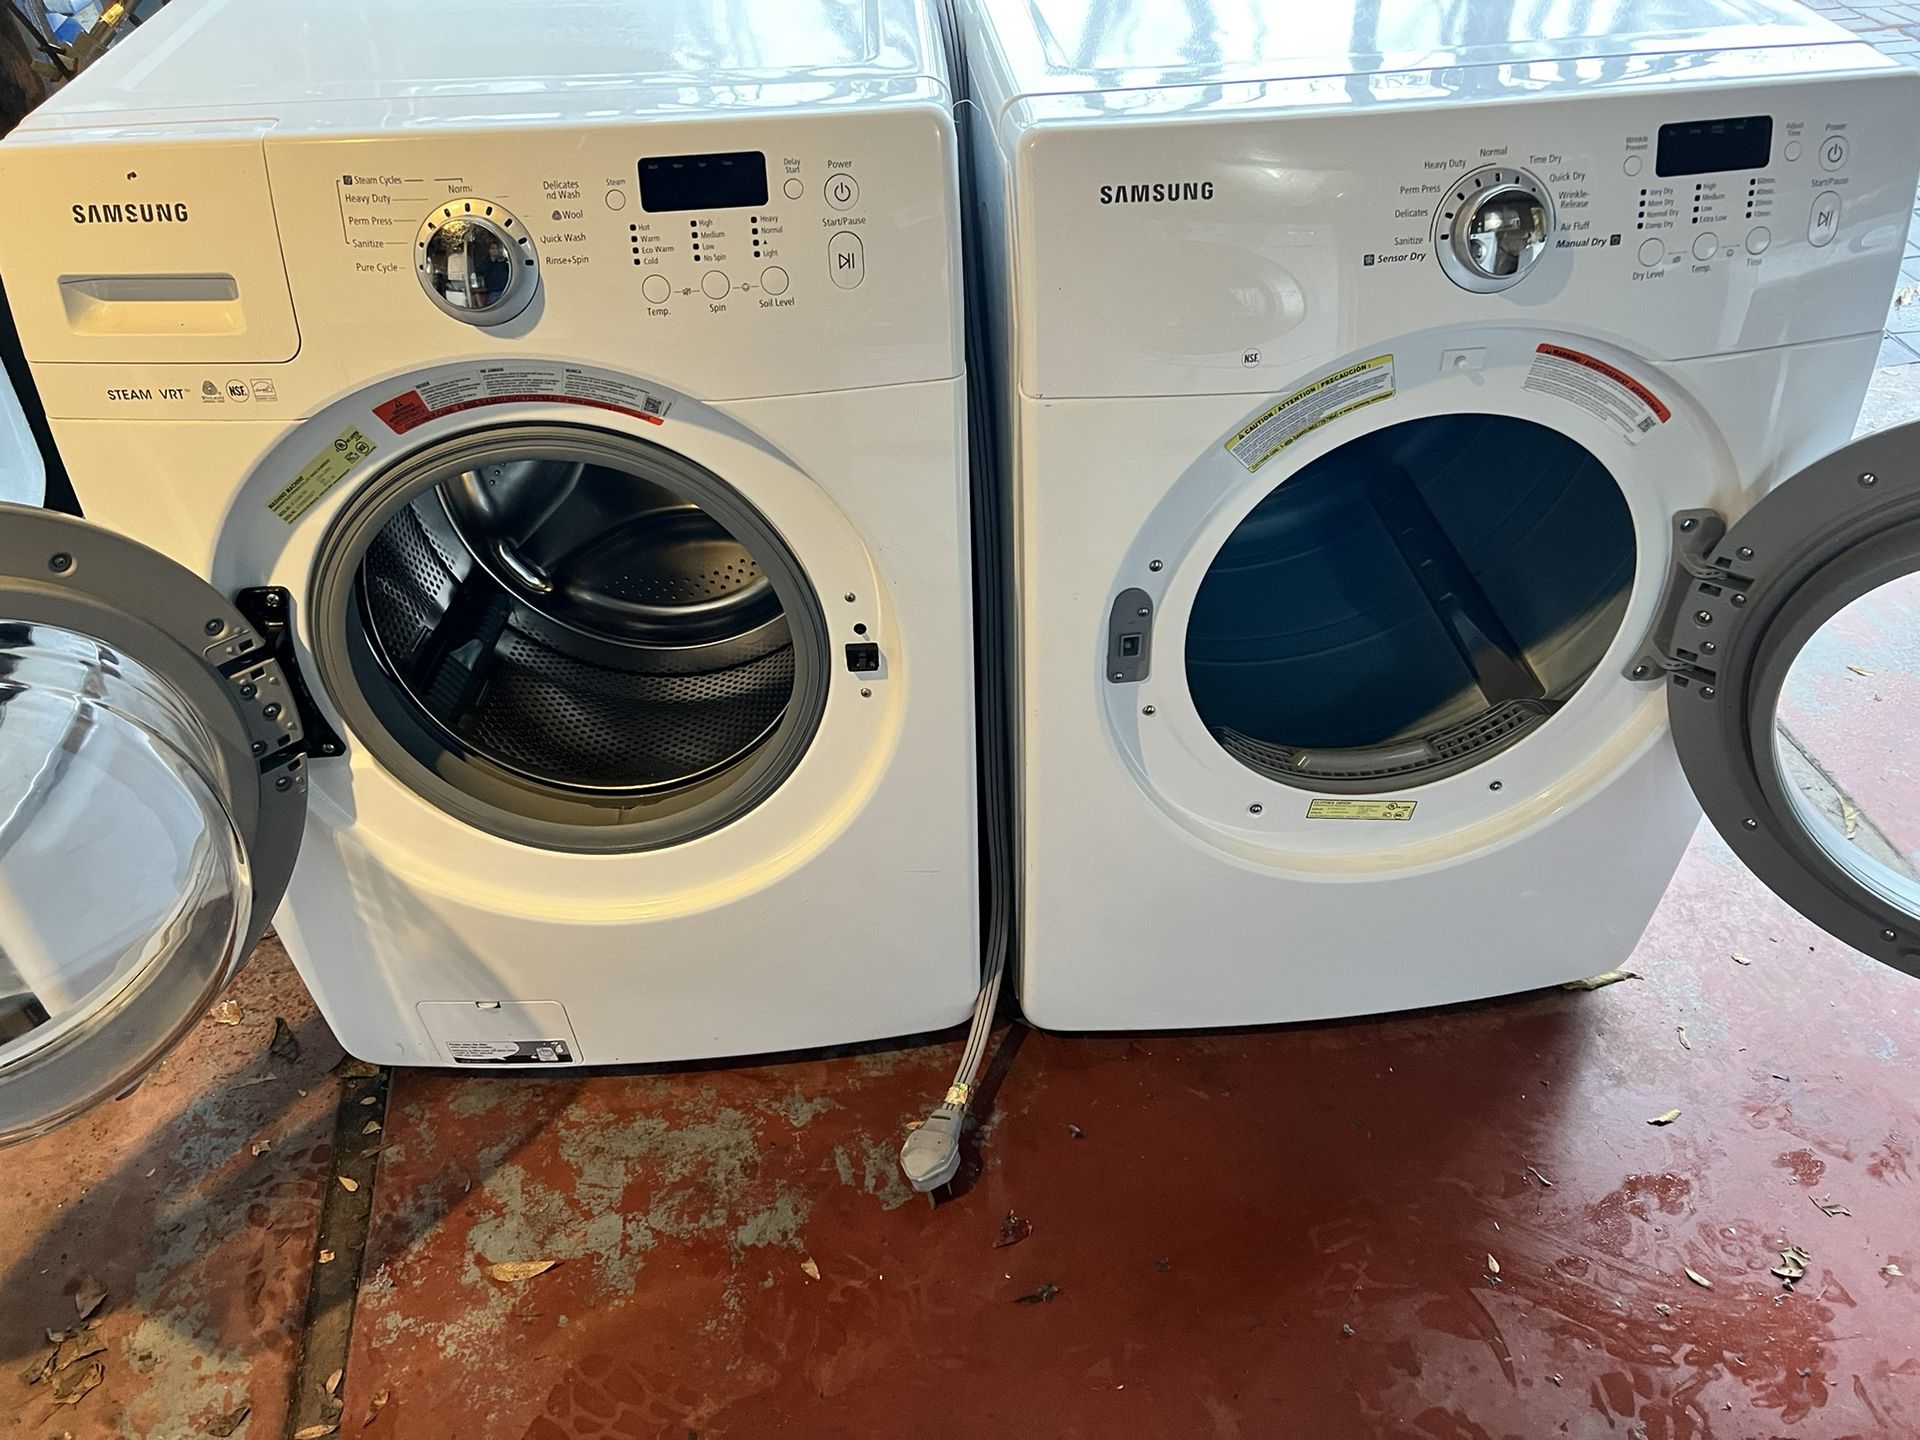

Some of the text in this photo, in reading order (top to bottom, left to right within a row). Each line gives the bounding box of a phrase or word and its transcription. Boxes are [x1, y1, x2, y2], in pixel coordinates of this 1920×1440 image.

[1825, 123, 1847, 131] Power
[1480, 147, 1508, 157] Normal
[1424, 159, 1467, 169] Heavy Duty
[1529, 154, 1562, 164] Time Dry
[828, 160, 852, 169] Power
[354, 176, 402, 186] Steam Cycles
[1550, 172, 1586, 182] Quick Dry
[1811, 177, 1849, 187] Start/Pause
[543, 181, 579, 189] Delicates
[1400, 184, 1441, 194] Perm Press
[1704, 182, 1716, 190] High
[559, 190, 581, 199] Wash
[1100, 182, 1214, 204] SAMSUNG
[1650, 187, 1674, 196] Very Dry
[345, 194, 391, 204] Heavy Duty
[1560, 200, 1589, 208] Release
[1664, 199, 1674, 207] Dry
[72, 203, 188, 223] SAMSUNG
[562, 210, 583, 219] Wool
[1395, 208, 1428, 218] Delicates
[1669, 209, 1679, 217] Dry
[349, 217, 393, 225] Perm Press
[699, 219, 713, 227] High
[760, 215, 778, 223] Heavy
[822, 217, 866, 227] Start/Pause
[1573, 221, 1590, 230] Fluff
[1664, 220, 1674, 229] Dry
[761, 226, 783, 234] Normal
[540, 233, 586, 244] Quick Wash
[1394, 236, 1423, 245] Sanitize
[1556, 237, 1607, 248] Manual Dry
[352, 240, 384, 248] Sanitize
[713, 253, 726, 261] Spin
[763, 250, 778, 258] Light
[1377, 252, 1426, 263] Sensor Dry
[545, 255, 589, 265] Rinse+Spin
[356, 263, 398, 273] Pure Cycle
[1632, 269, 1664, 281] Dry Level
[759, 297, 795, 307] Soil Level
[647, 308, 671, 316] Temp.
[710, 304, 726, 314] Spin
[107, 389, 152, 401] STEAM
[1244, 411, 1273, 434] CAUTION
[1276, 386, 1316, 411] ATTENTION
[1320, 364, 1367, 387] PRECAUCIÓN
